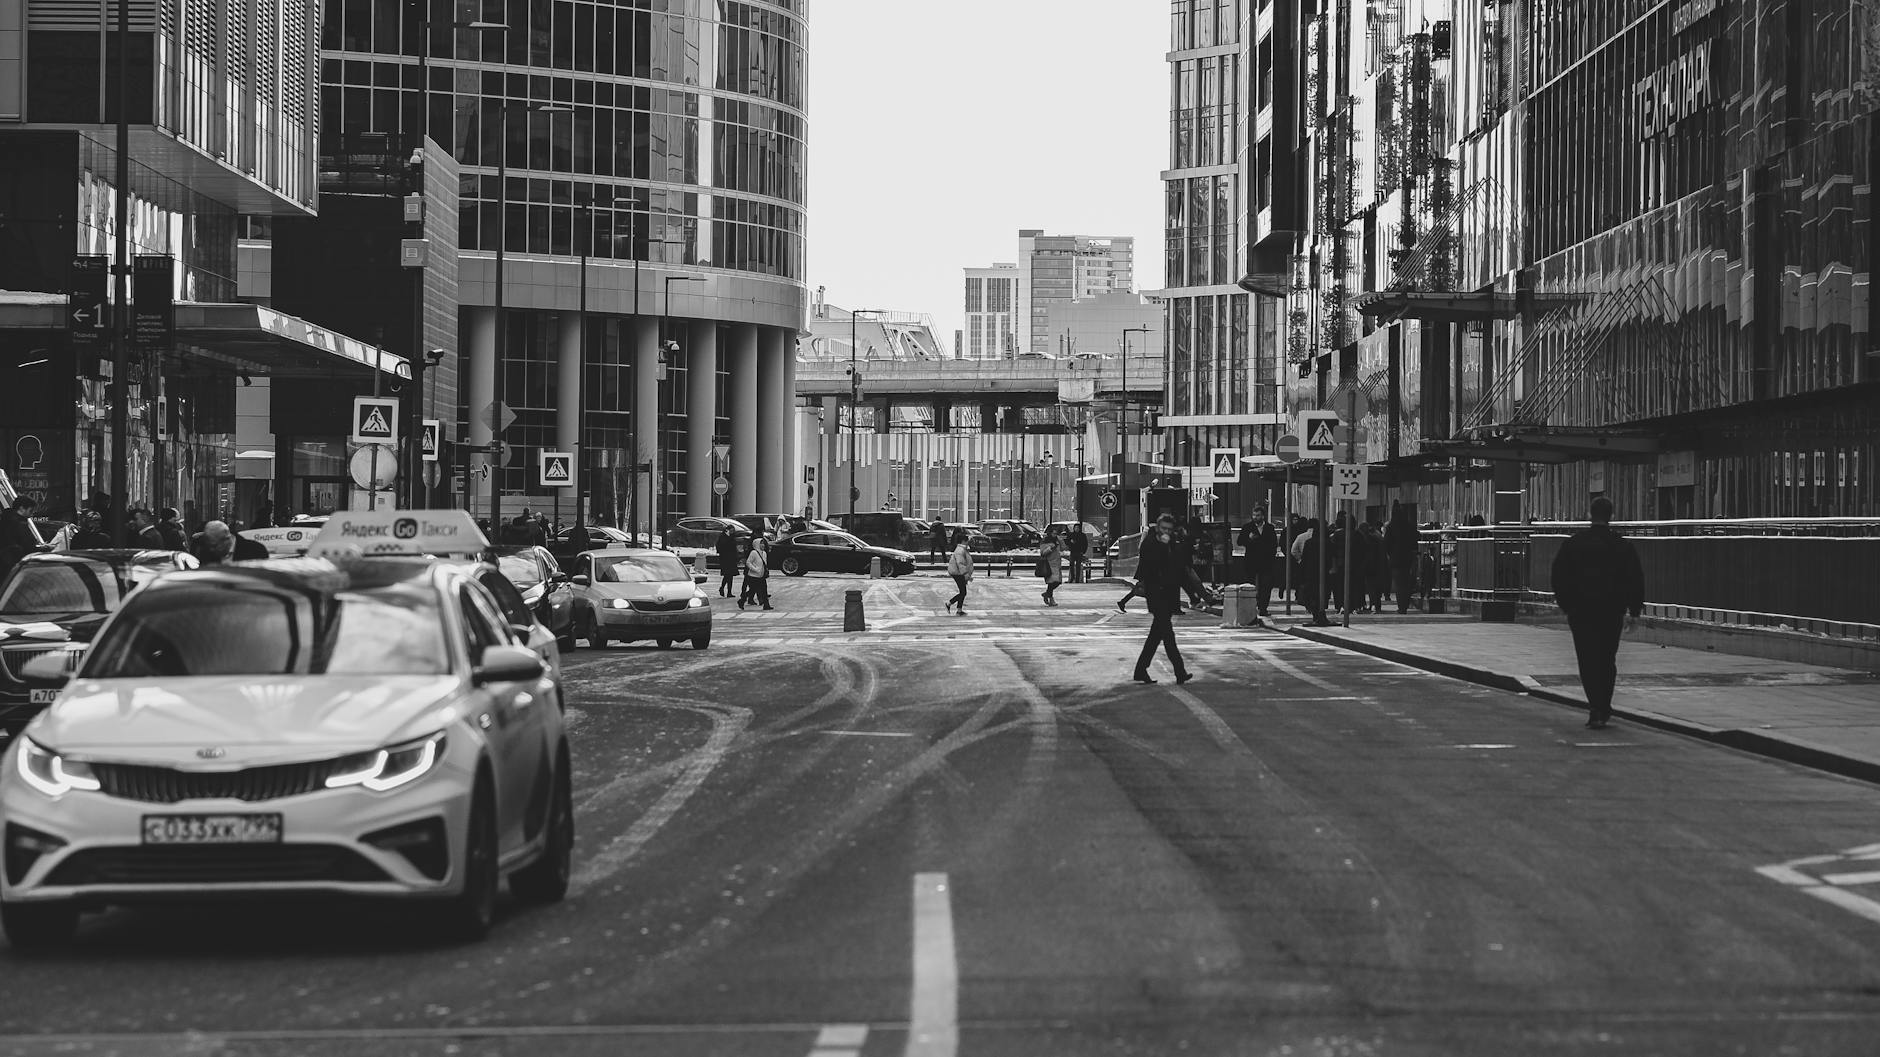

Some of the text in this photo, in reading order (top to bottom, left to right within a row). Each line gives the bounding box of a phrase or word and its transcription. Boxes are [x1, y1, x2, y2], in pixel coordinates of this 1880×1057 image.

[1637, 37, 1712, 143] ТЕХНОПАРК
[93, 303, 104, 328] 1
[1340, 481, 1360, 495] T2
[288, 532, 302, 540] Go
[341, 521, 458, 537] Яндекс Go Такси
